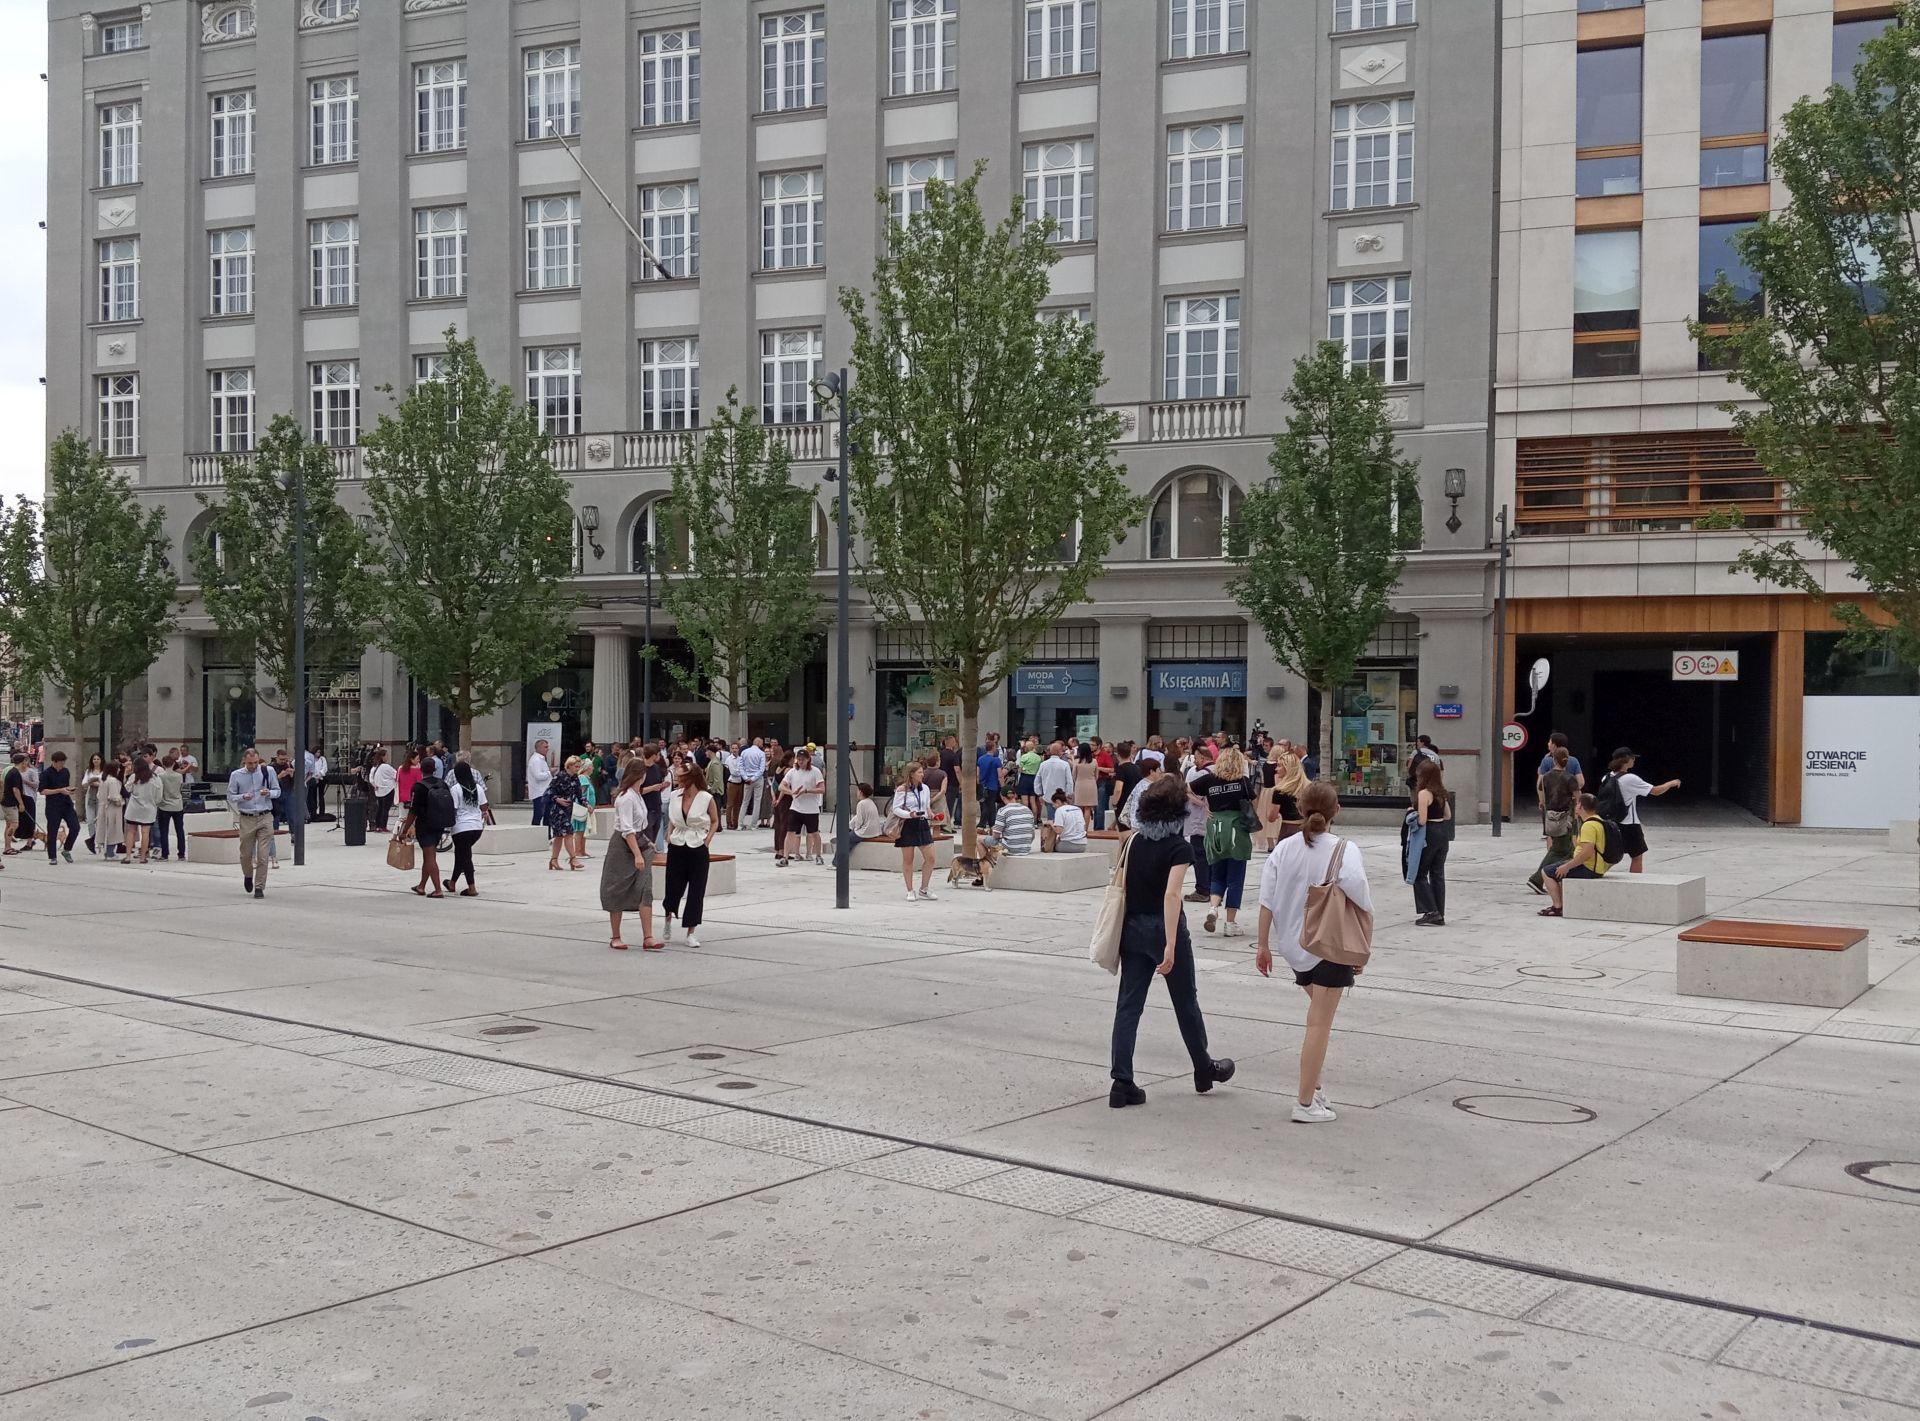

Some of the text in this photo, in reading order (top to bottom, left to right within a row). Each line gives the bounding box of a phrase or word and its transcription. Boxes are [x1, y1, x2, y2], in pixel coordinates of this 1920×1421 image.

[1682, 661, 1689, 670] 5
[1028, 671, 1054, 679] MODA
[1502, 732, 1522, 741] LPG
[1806, 750, 1867, 760] OTWARCIE
[1806, 760, 1857, 773] JESIENIĄ
